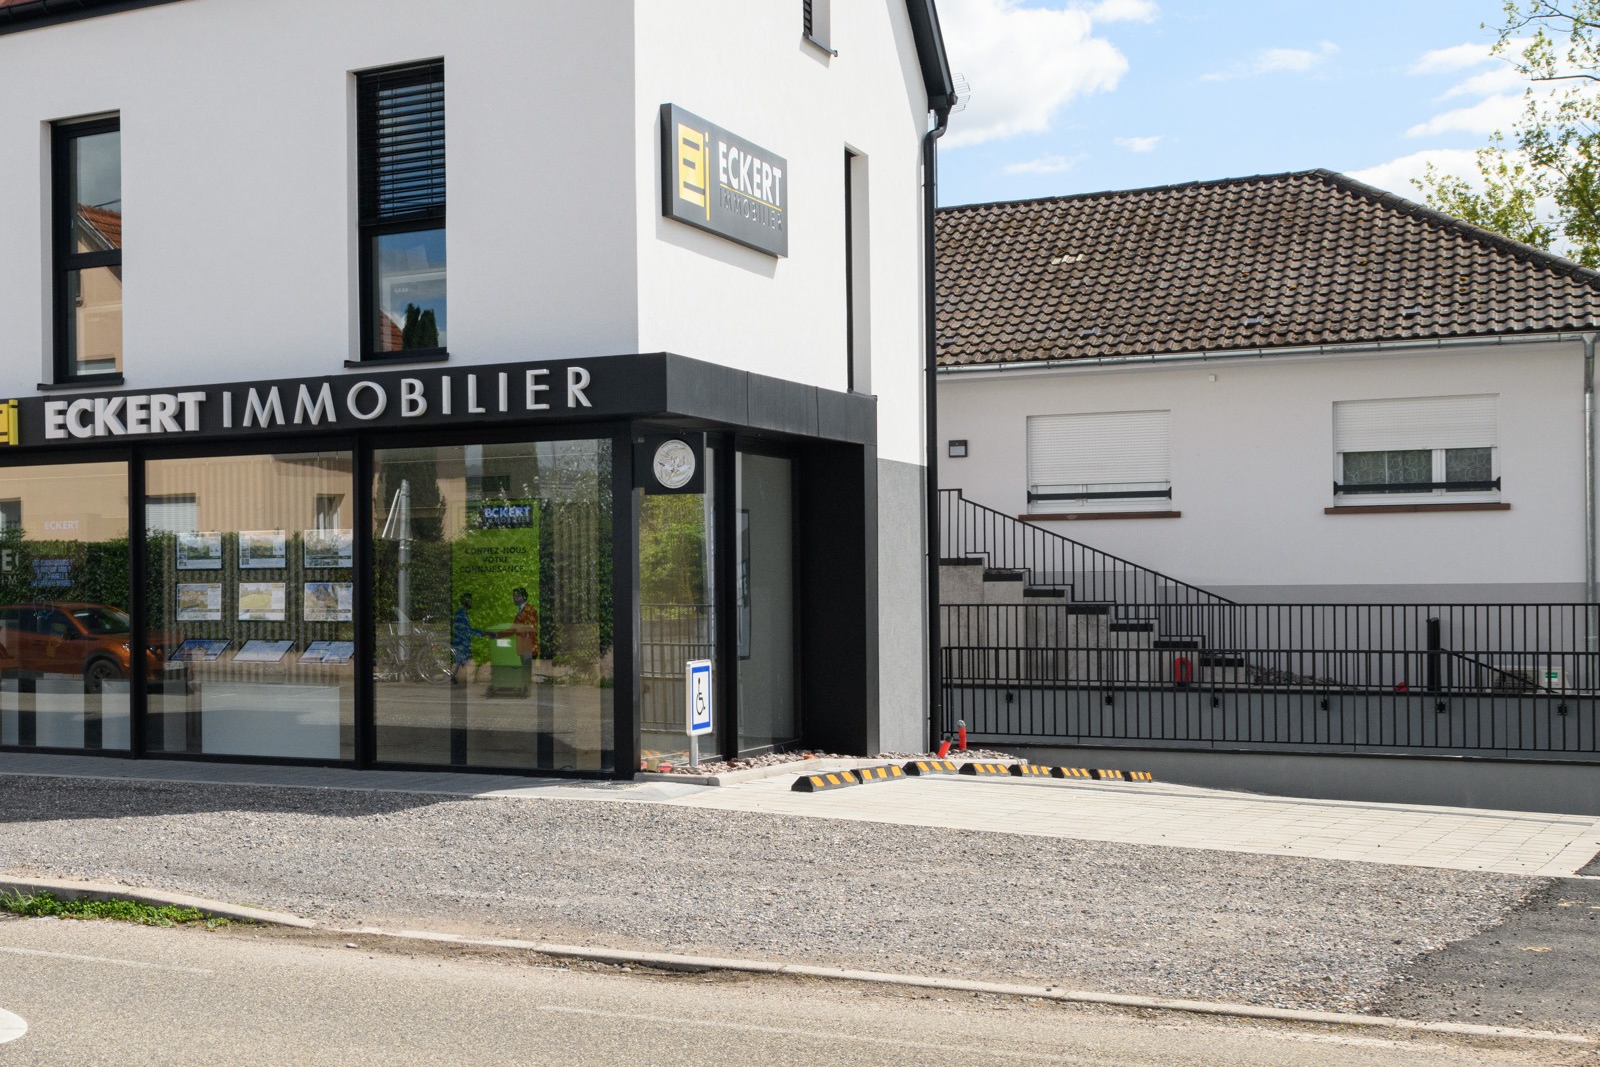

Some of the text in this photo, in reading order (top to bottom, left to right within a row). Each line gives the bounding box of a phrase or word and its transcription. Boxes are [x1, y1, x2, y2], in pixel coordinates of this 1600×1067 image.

[718, 141, 782, 207] ECKERT
[719, 187, 783, 232] IMMOBILIER
[45, 391, 206, 439] ECKERT
[223, 367, 593, 429] IMMOBILIER
[44, 520, 80, 531] ECKERT
